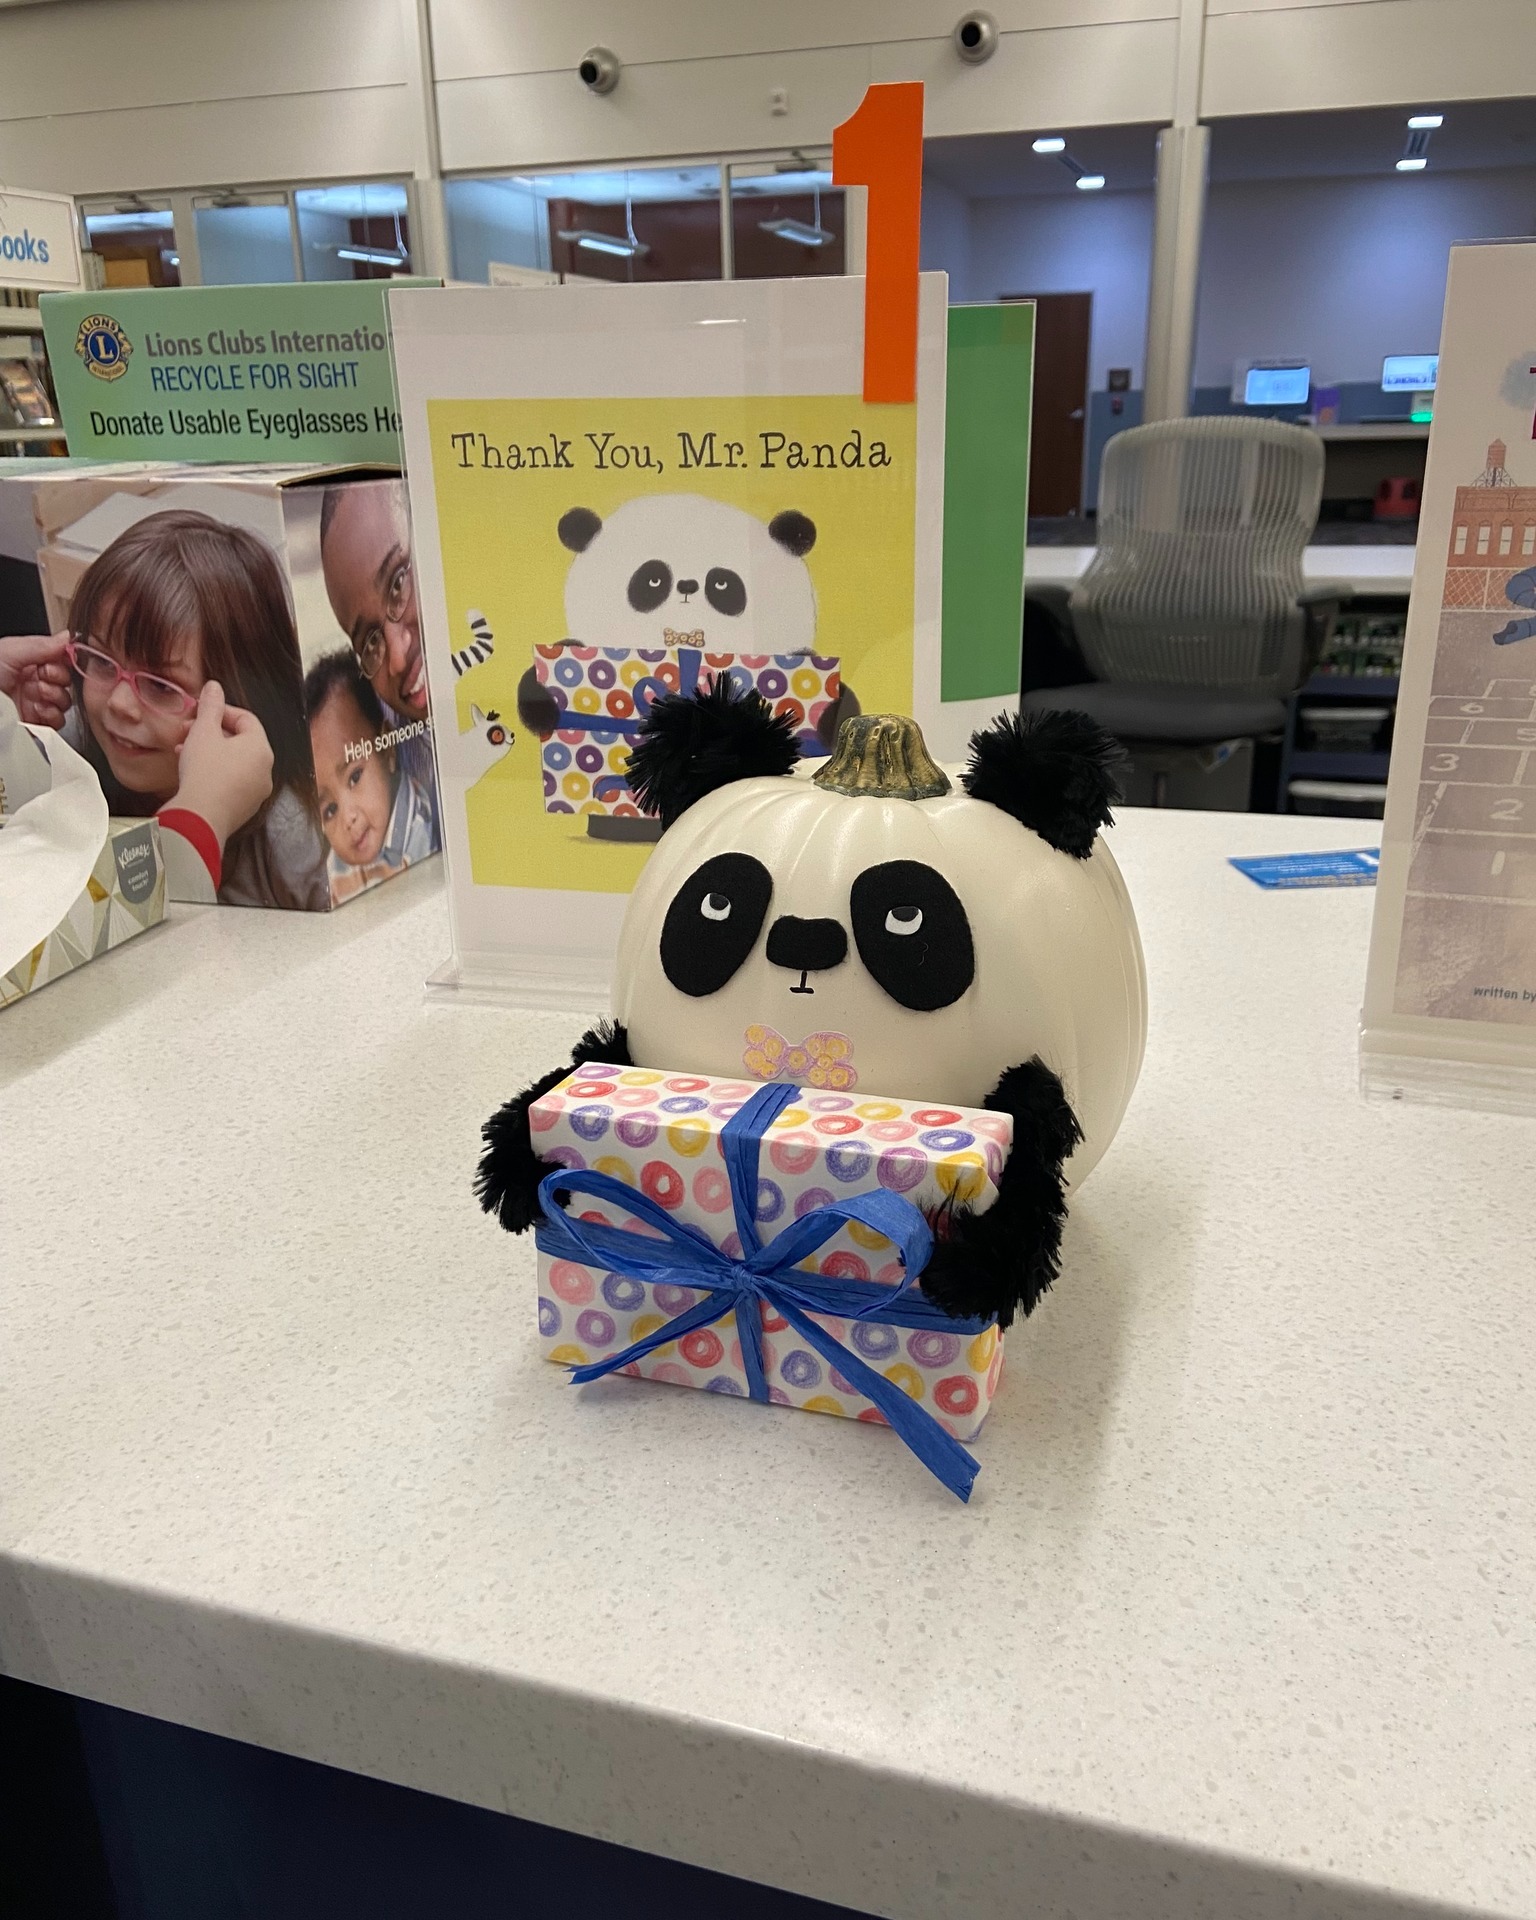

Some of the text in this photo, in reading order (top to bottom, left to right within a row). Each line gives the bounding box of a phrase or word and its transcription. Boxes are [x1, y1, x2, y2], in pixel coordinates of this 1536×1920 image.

[0, 228, 49, 263] ooks
[831, 81, 924, 404] 1
[83, 317, 118, 331] LIONS
[96, 335, 114, 359] L
[145, 332, 203, 357] Lions
[207, 329, 266, 355] Clubs
[150, 364, 245, 392] RECYCLE
[249, 363, 292, 389] FOR
[297, 361, 359, 389] SIGHT
[90, 410, 165, 436] Donate
[168, 408, 242, 435] Usable
[246, 407, 369, 440] Eyeglasses
[451, 429, 892, 474] Thank You, Mr. Panda
[344, 737, 373, 763] Help
[375, 720, 424, 752] someone
[1429, 753, 1460, 772] 3
[1489, 798, 1524, 820] 2
[1473, 986, 1518, 1000] written
